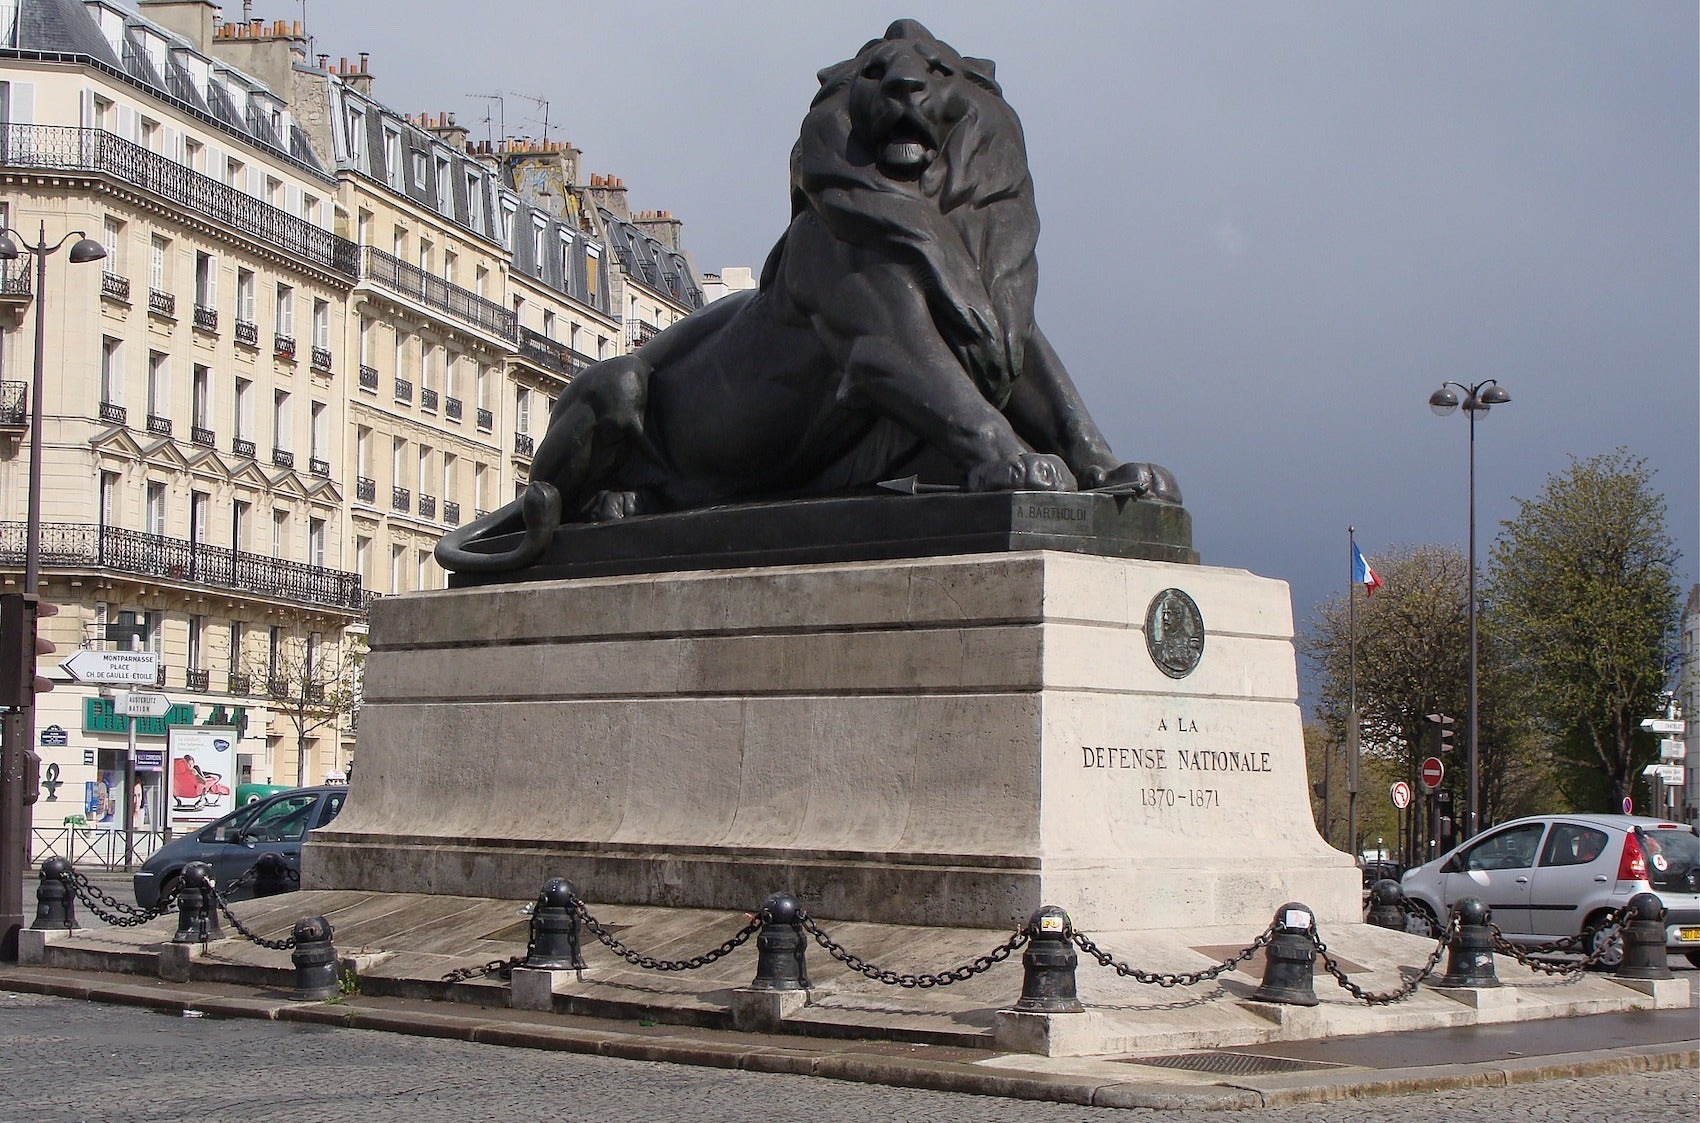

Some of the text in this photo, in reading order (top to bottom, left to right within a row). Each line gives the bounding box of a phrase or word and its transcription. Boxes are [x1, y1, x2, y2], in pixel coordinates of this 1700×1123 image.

[1029, 506, 1086, 521] BARTHOLDI
[103, 654, 153, 663] MONTPARNASSE
[129, 696, 156, 704] AUSTERLITZ
[1158, 717, 1199, 733] A LA
[1081, 746, 1272, 772] DEFENSE NATIONALE
[1141, 788, 1220, 809] 1870-1871
